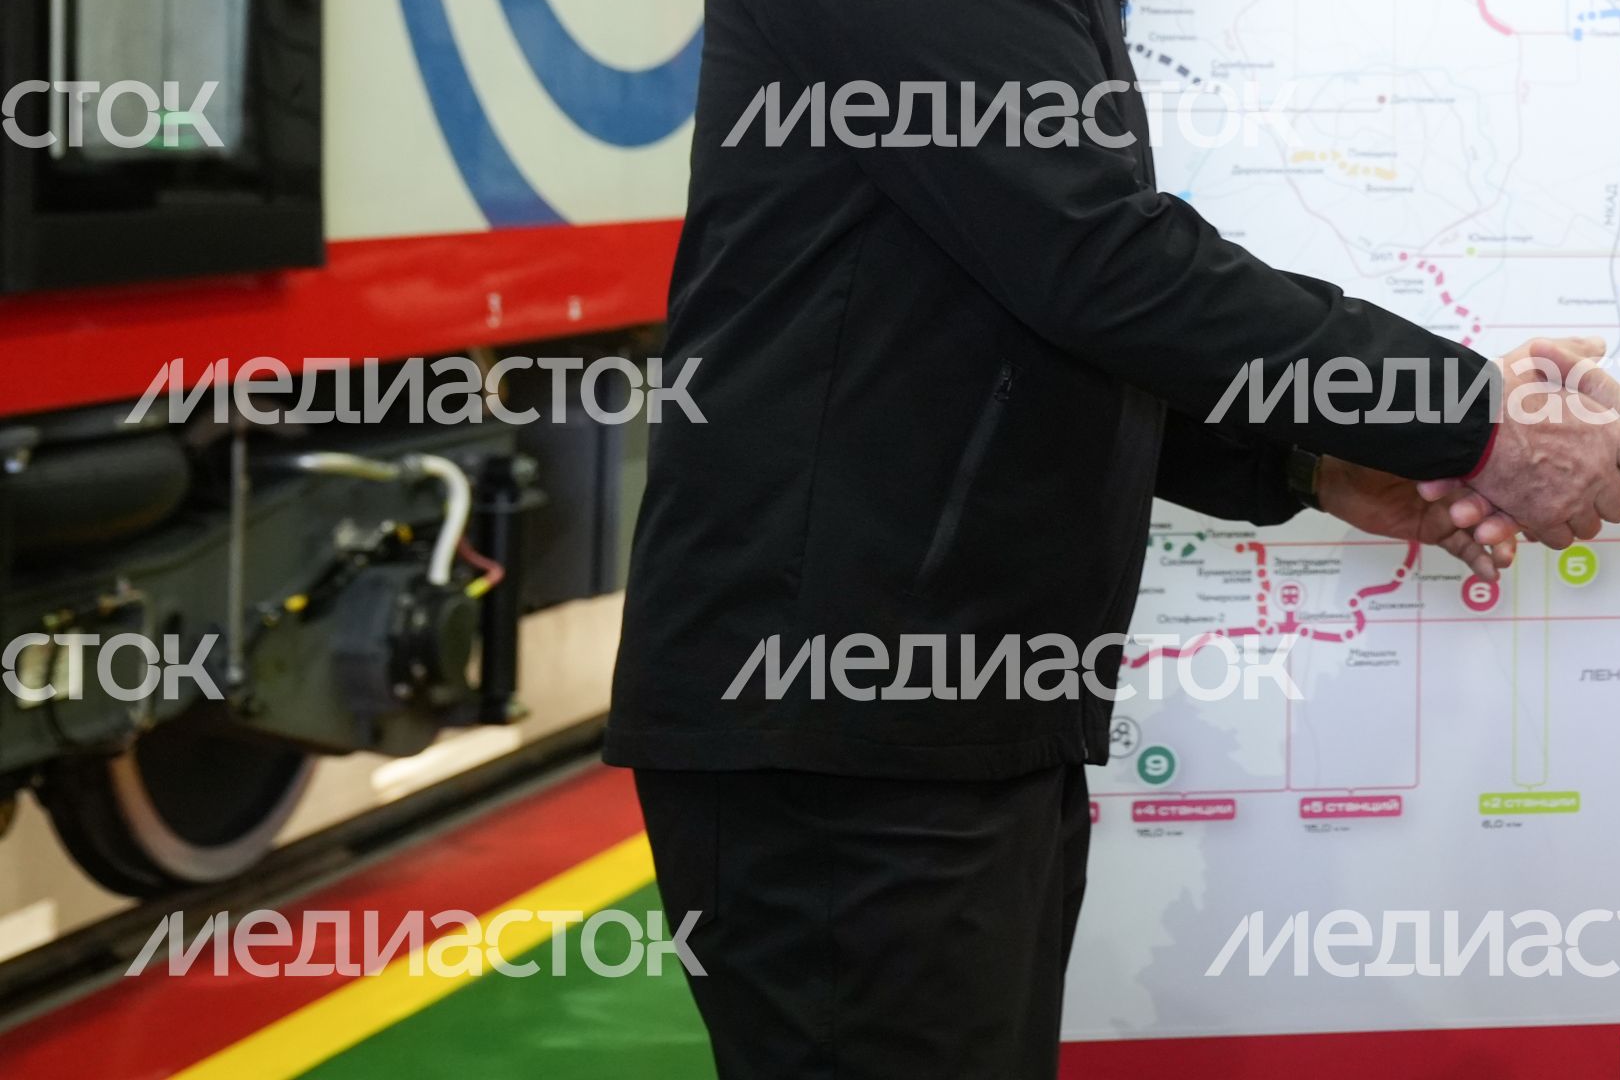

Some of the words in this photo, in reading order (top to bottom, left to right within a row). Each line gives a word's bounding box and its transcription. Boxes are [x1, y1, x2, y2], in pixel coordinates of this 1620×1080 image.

[1565, 557, 1588, 577] 5
[1468, 582, 1492, 604] 6
[1145, 754, 1168, 777] 9
